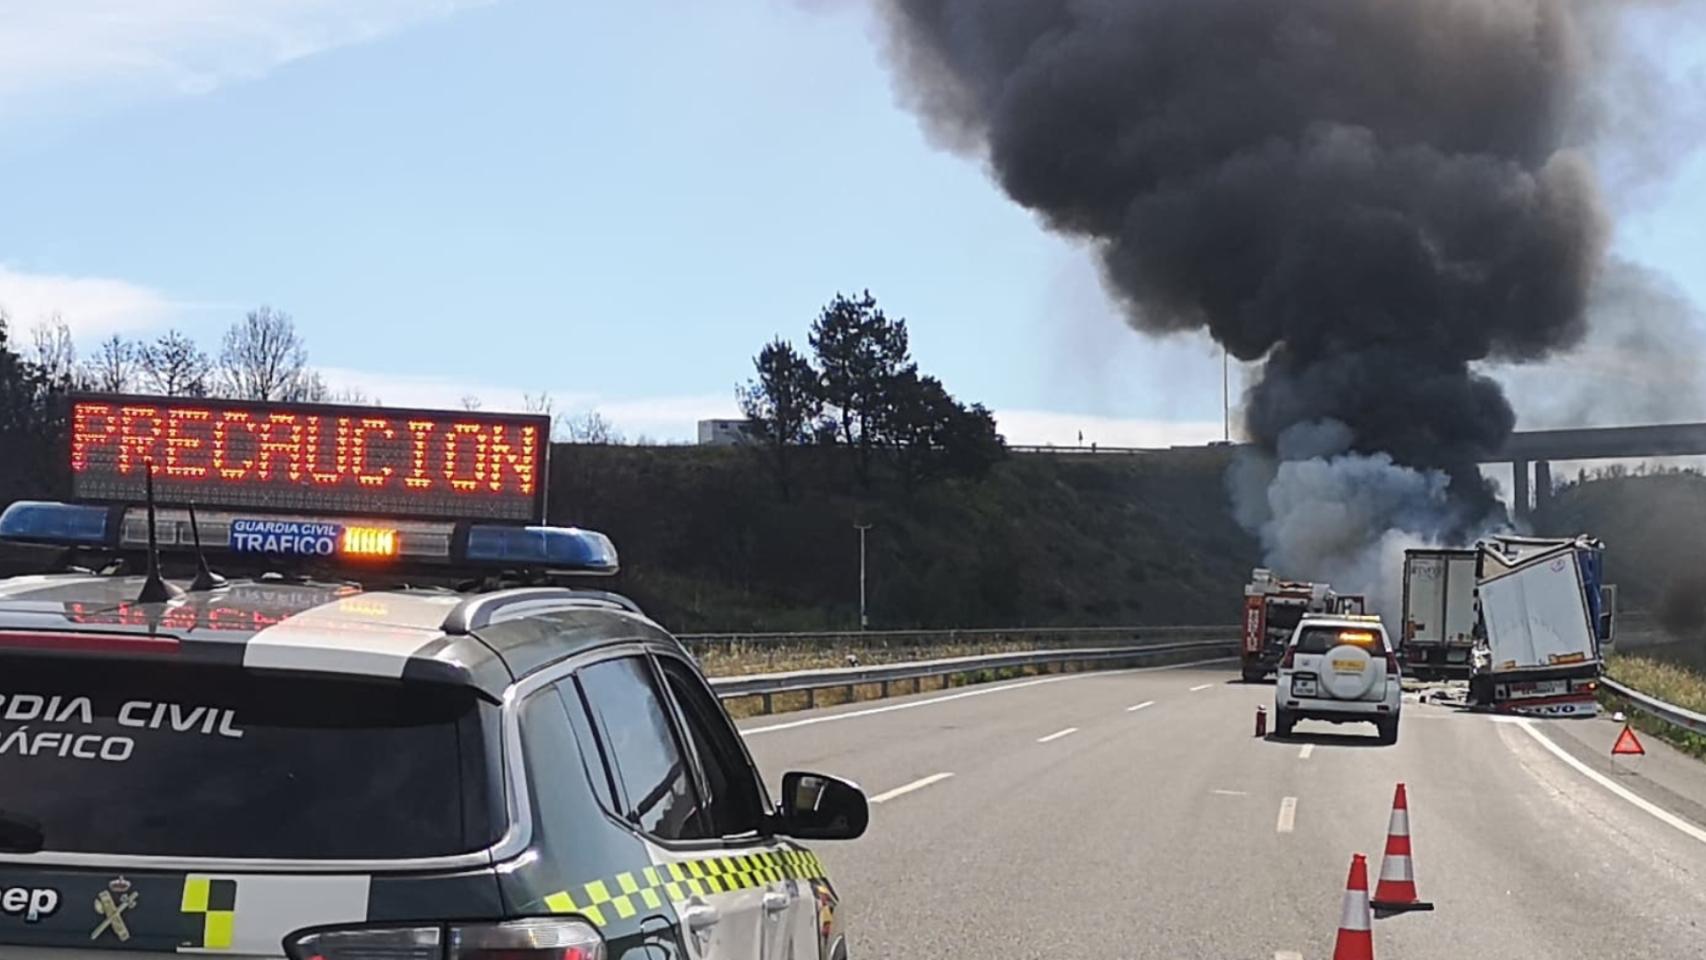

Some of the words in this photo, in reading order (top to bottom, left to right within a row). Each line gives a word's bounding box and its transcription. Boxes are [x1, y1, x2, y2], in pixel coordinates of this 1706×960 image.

[73, 403, 537, 494] PRECAUCION
[233, 533, 334, 555] TRAFICO
[234, 521, 298, 534] GUARDIA
[301, 523, 337, 536] CIVIL
[0, 694, 92, 724] DIA
[118, 701, 244, 737] CIVIL
[0, 725, 134, 761] ÁFICO
[0, 888, 58, 921] ep
